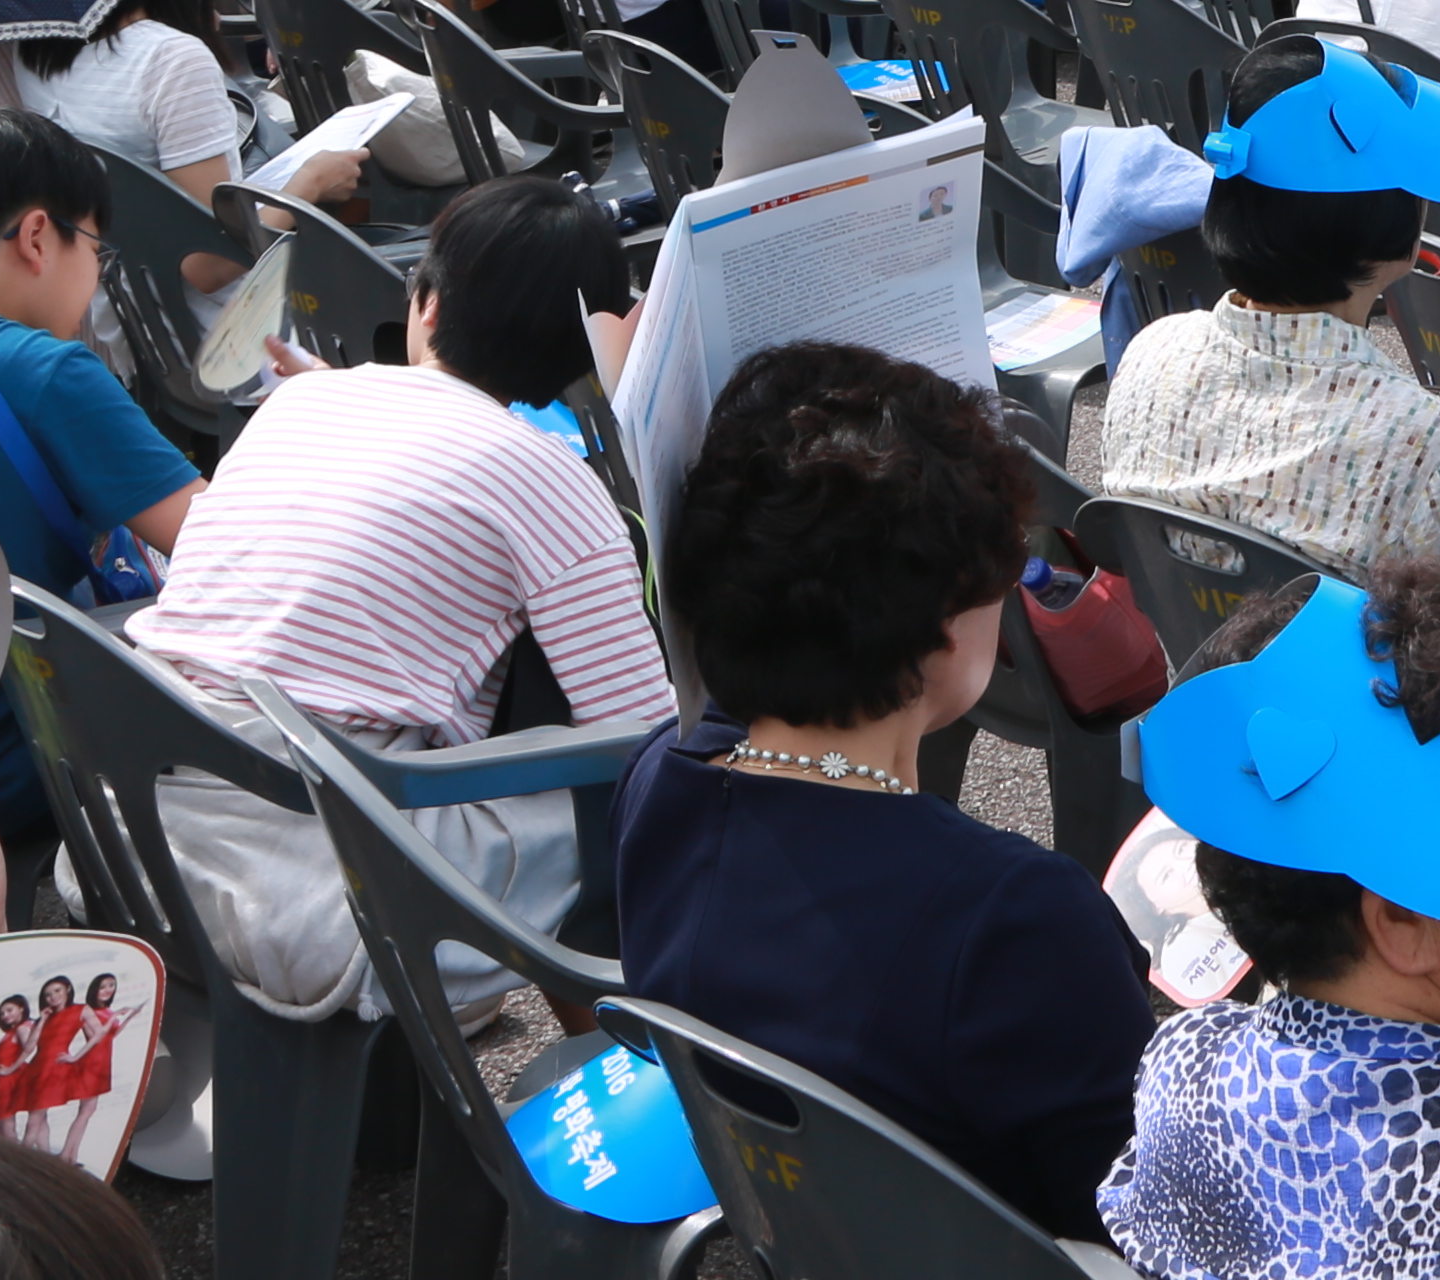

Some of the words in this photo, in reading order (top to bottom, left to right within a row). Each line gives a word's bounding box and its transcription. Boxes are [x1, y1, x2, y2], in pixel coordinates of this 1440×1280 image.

[911, 5, 941, 27] VIP
[1139, 246, 1177, 271] VIP
[601, 1048, 636, 1096] 2016
[553, 1089, 617, 1192] 평화축제
